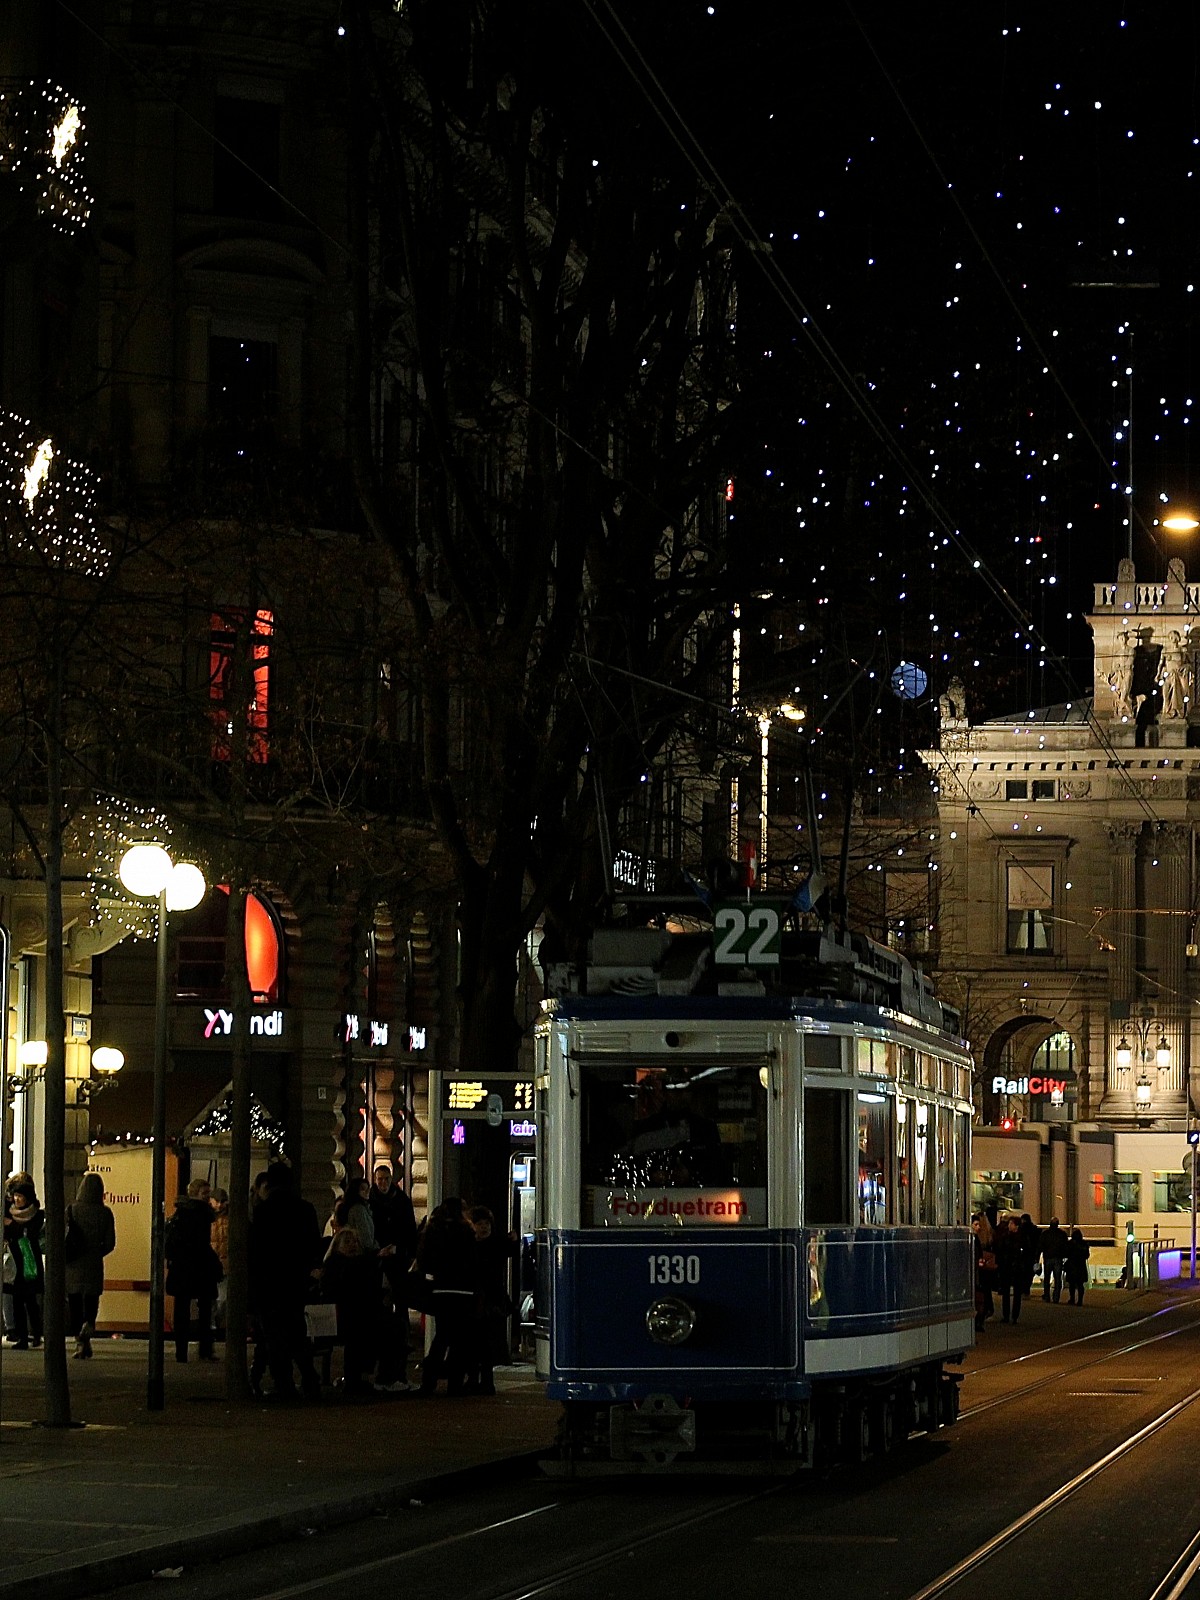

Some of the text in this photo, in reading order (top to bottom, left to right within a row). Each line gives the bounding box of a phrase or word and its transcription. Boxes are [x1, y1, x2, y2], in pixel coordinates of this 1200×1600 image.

[715, 908, 779, 964] 22
[203, 1008, 283, 1038] Y.Yndi
[992, 1076, 1067, 1095] RailCity
[613, 1197, 748, 1216] Fonduetram
[648, 1255, 700, 1284] 1330
